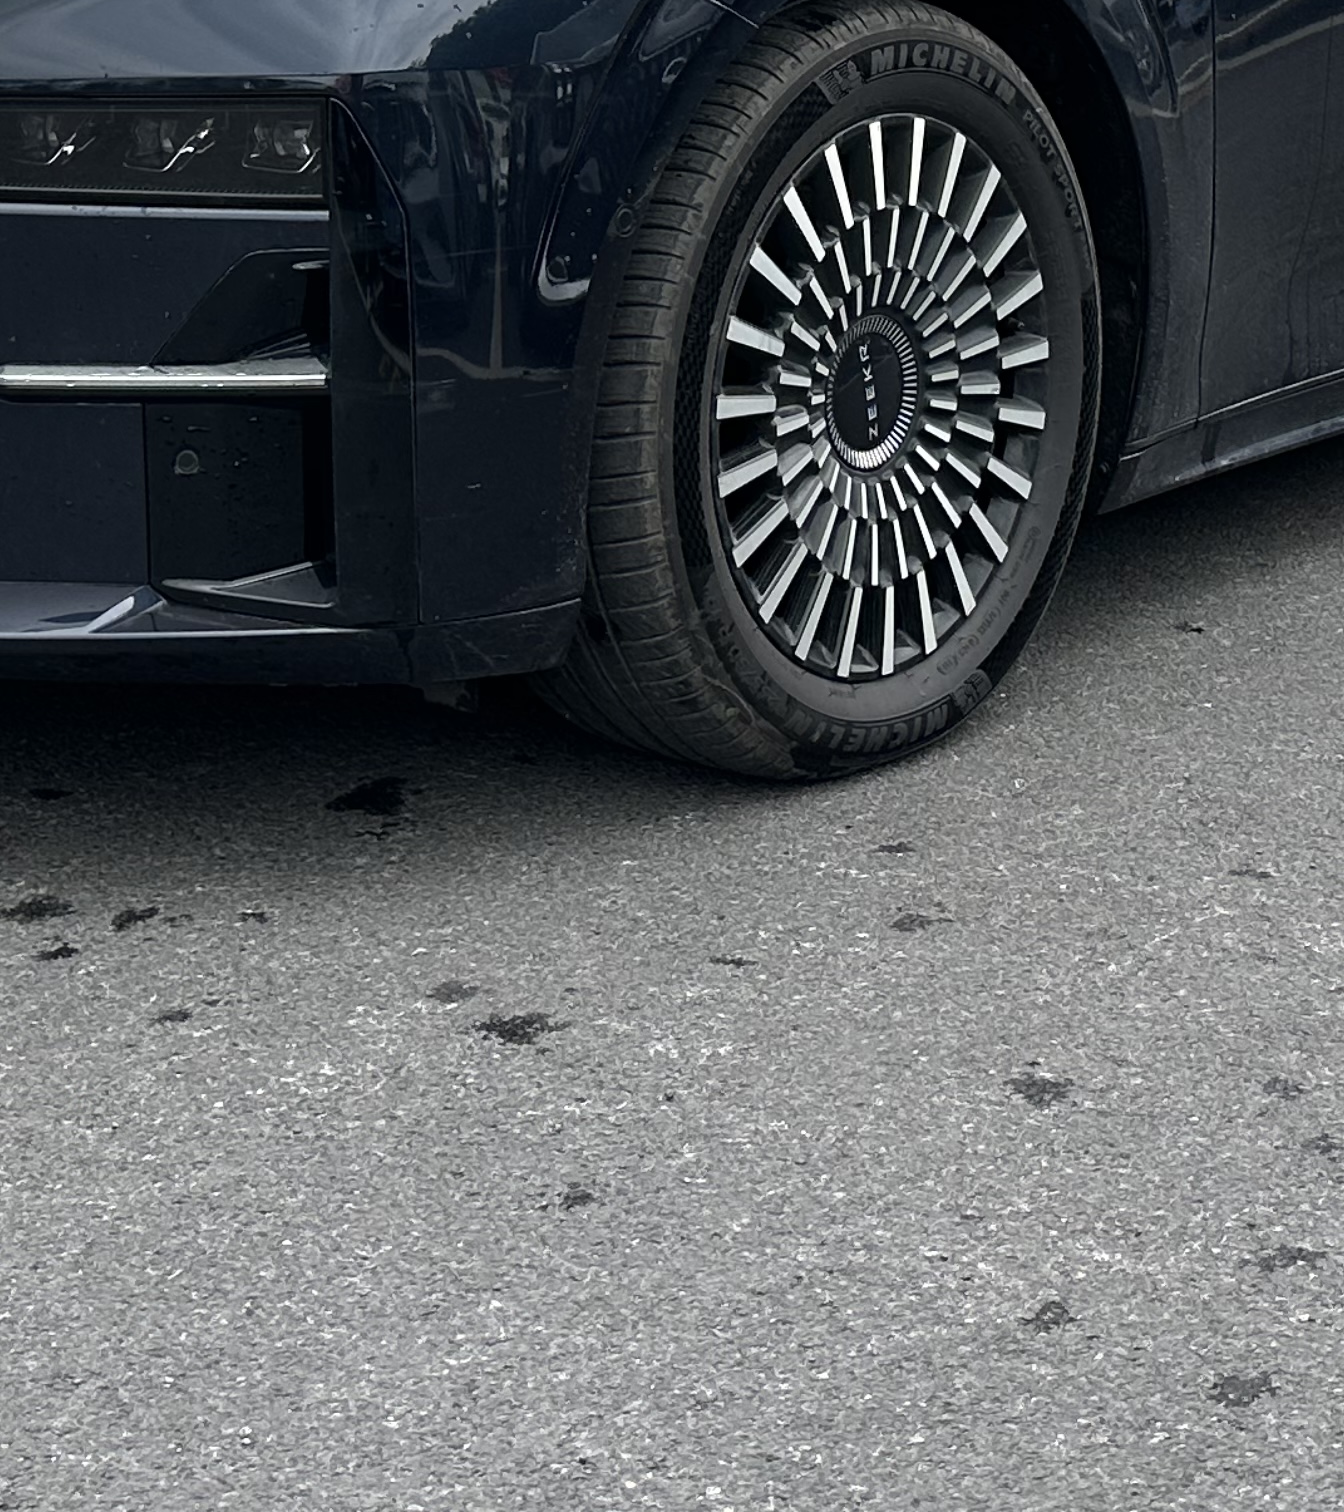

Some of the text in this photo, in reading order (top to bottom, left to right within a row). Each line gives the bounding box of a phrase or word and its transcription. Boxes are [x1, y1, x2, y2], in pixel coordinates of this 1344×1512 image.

[870, 42, 1016, 105] MICHELIN
[1022, 109, 1056, 158] PILOT
[858, 343, 879, 440] ZEEKR
